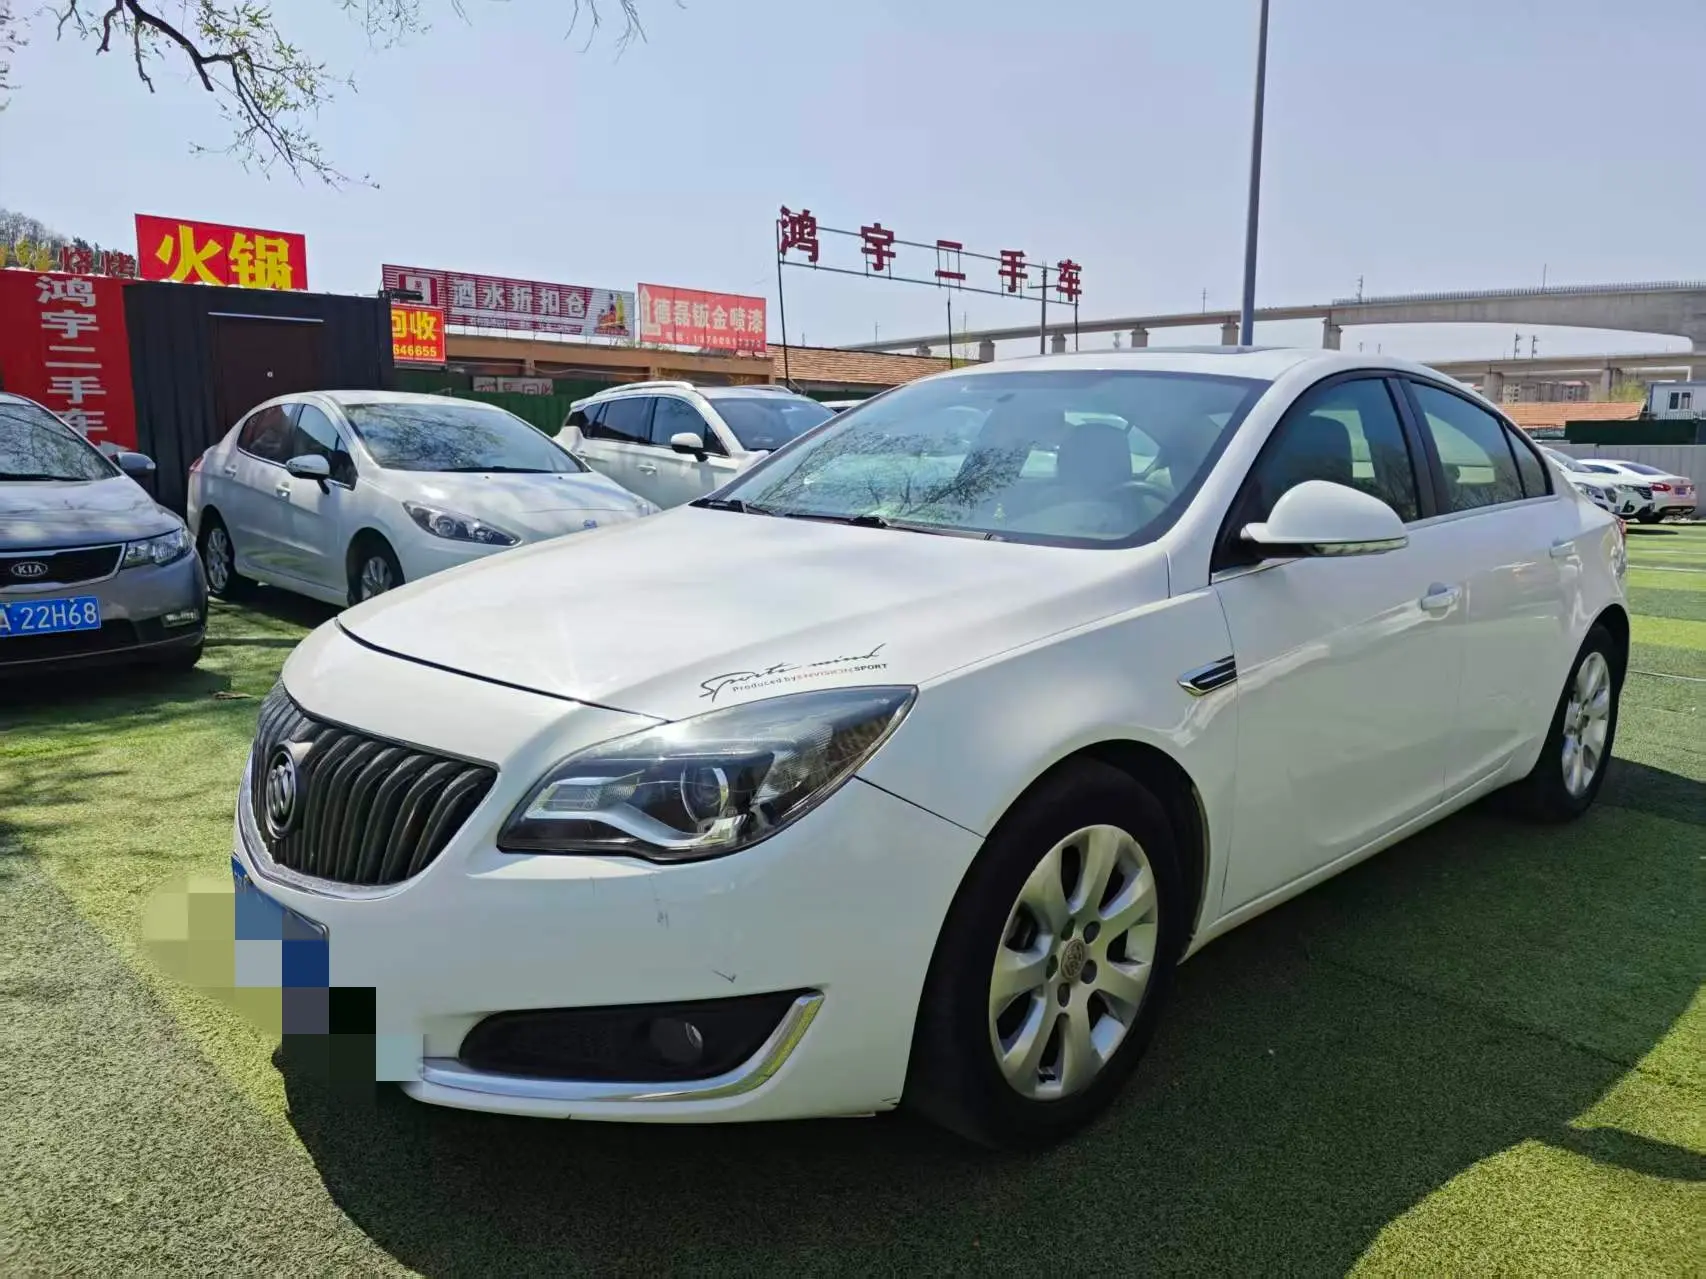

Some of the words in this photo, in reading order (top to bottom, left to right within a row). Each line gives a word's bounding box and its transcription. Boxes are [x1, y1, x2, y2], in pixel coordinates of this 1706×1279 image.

[155, 225, 293, 290] 火锅
[780, 205, 1082, 301] 鸿宇二手车
[452, 278, 586, 317] 酒水折扣仓
[18, 564, 43, 574] KIA
[732, 676, 782, 692] Produced
